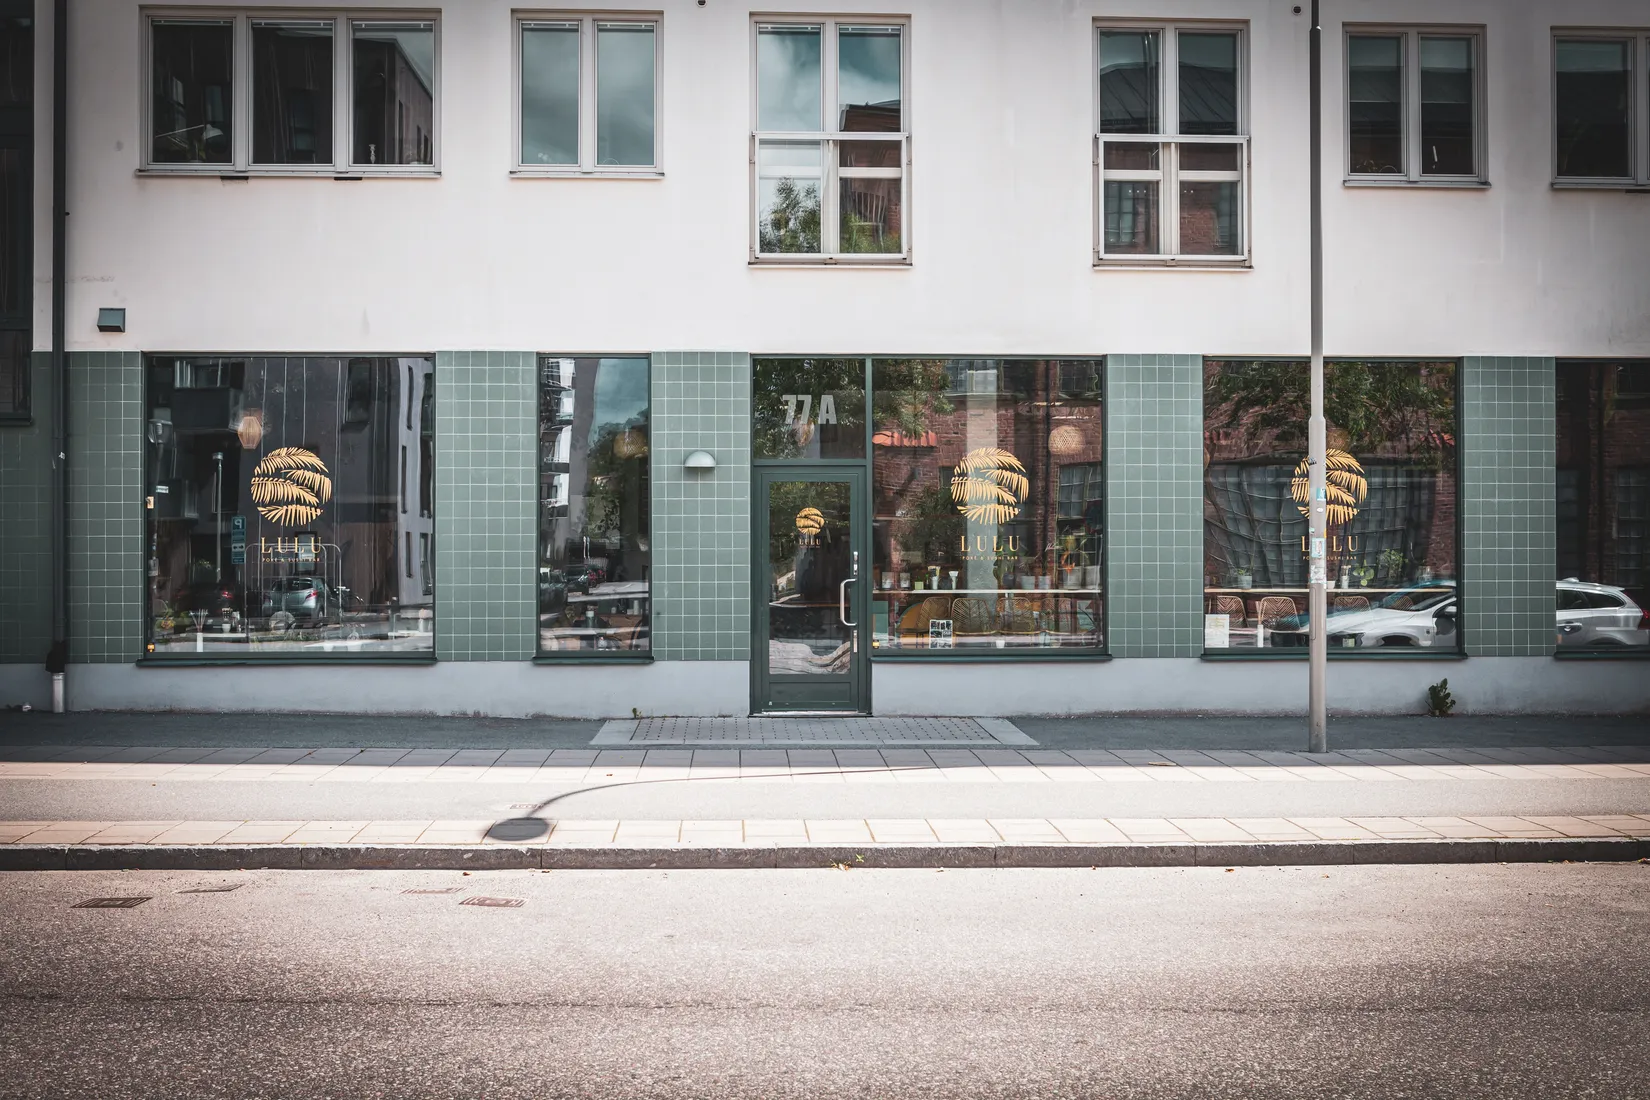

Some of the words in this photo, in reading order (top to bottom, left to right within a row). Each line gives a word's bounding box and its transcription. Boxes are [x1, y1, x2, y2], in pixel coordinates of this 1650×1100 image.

[261, 536, 321, 553] LULU
[799, 538, 821, 546] LULU
[961, 535, 1019, 552] LULU
[1301, 535, 1358, 552] LLU
